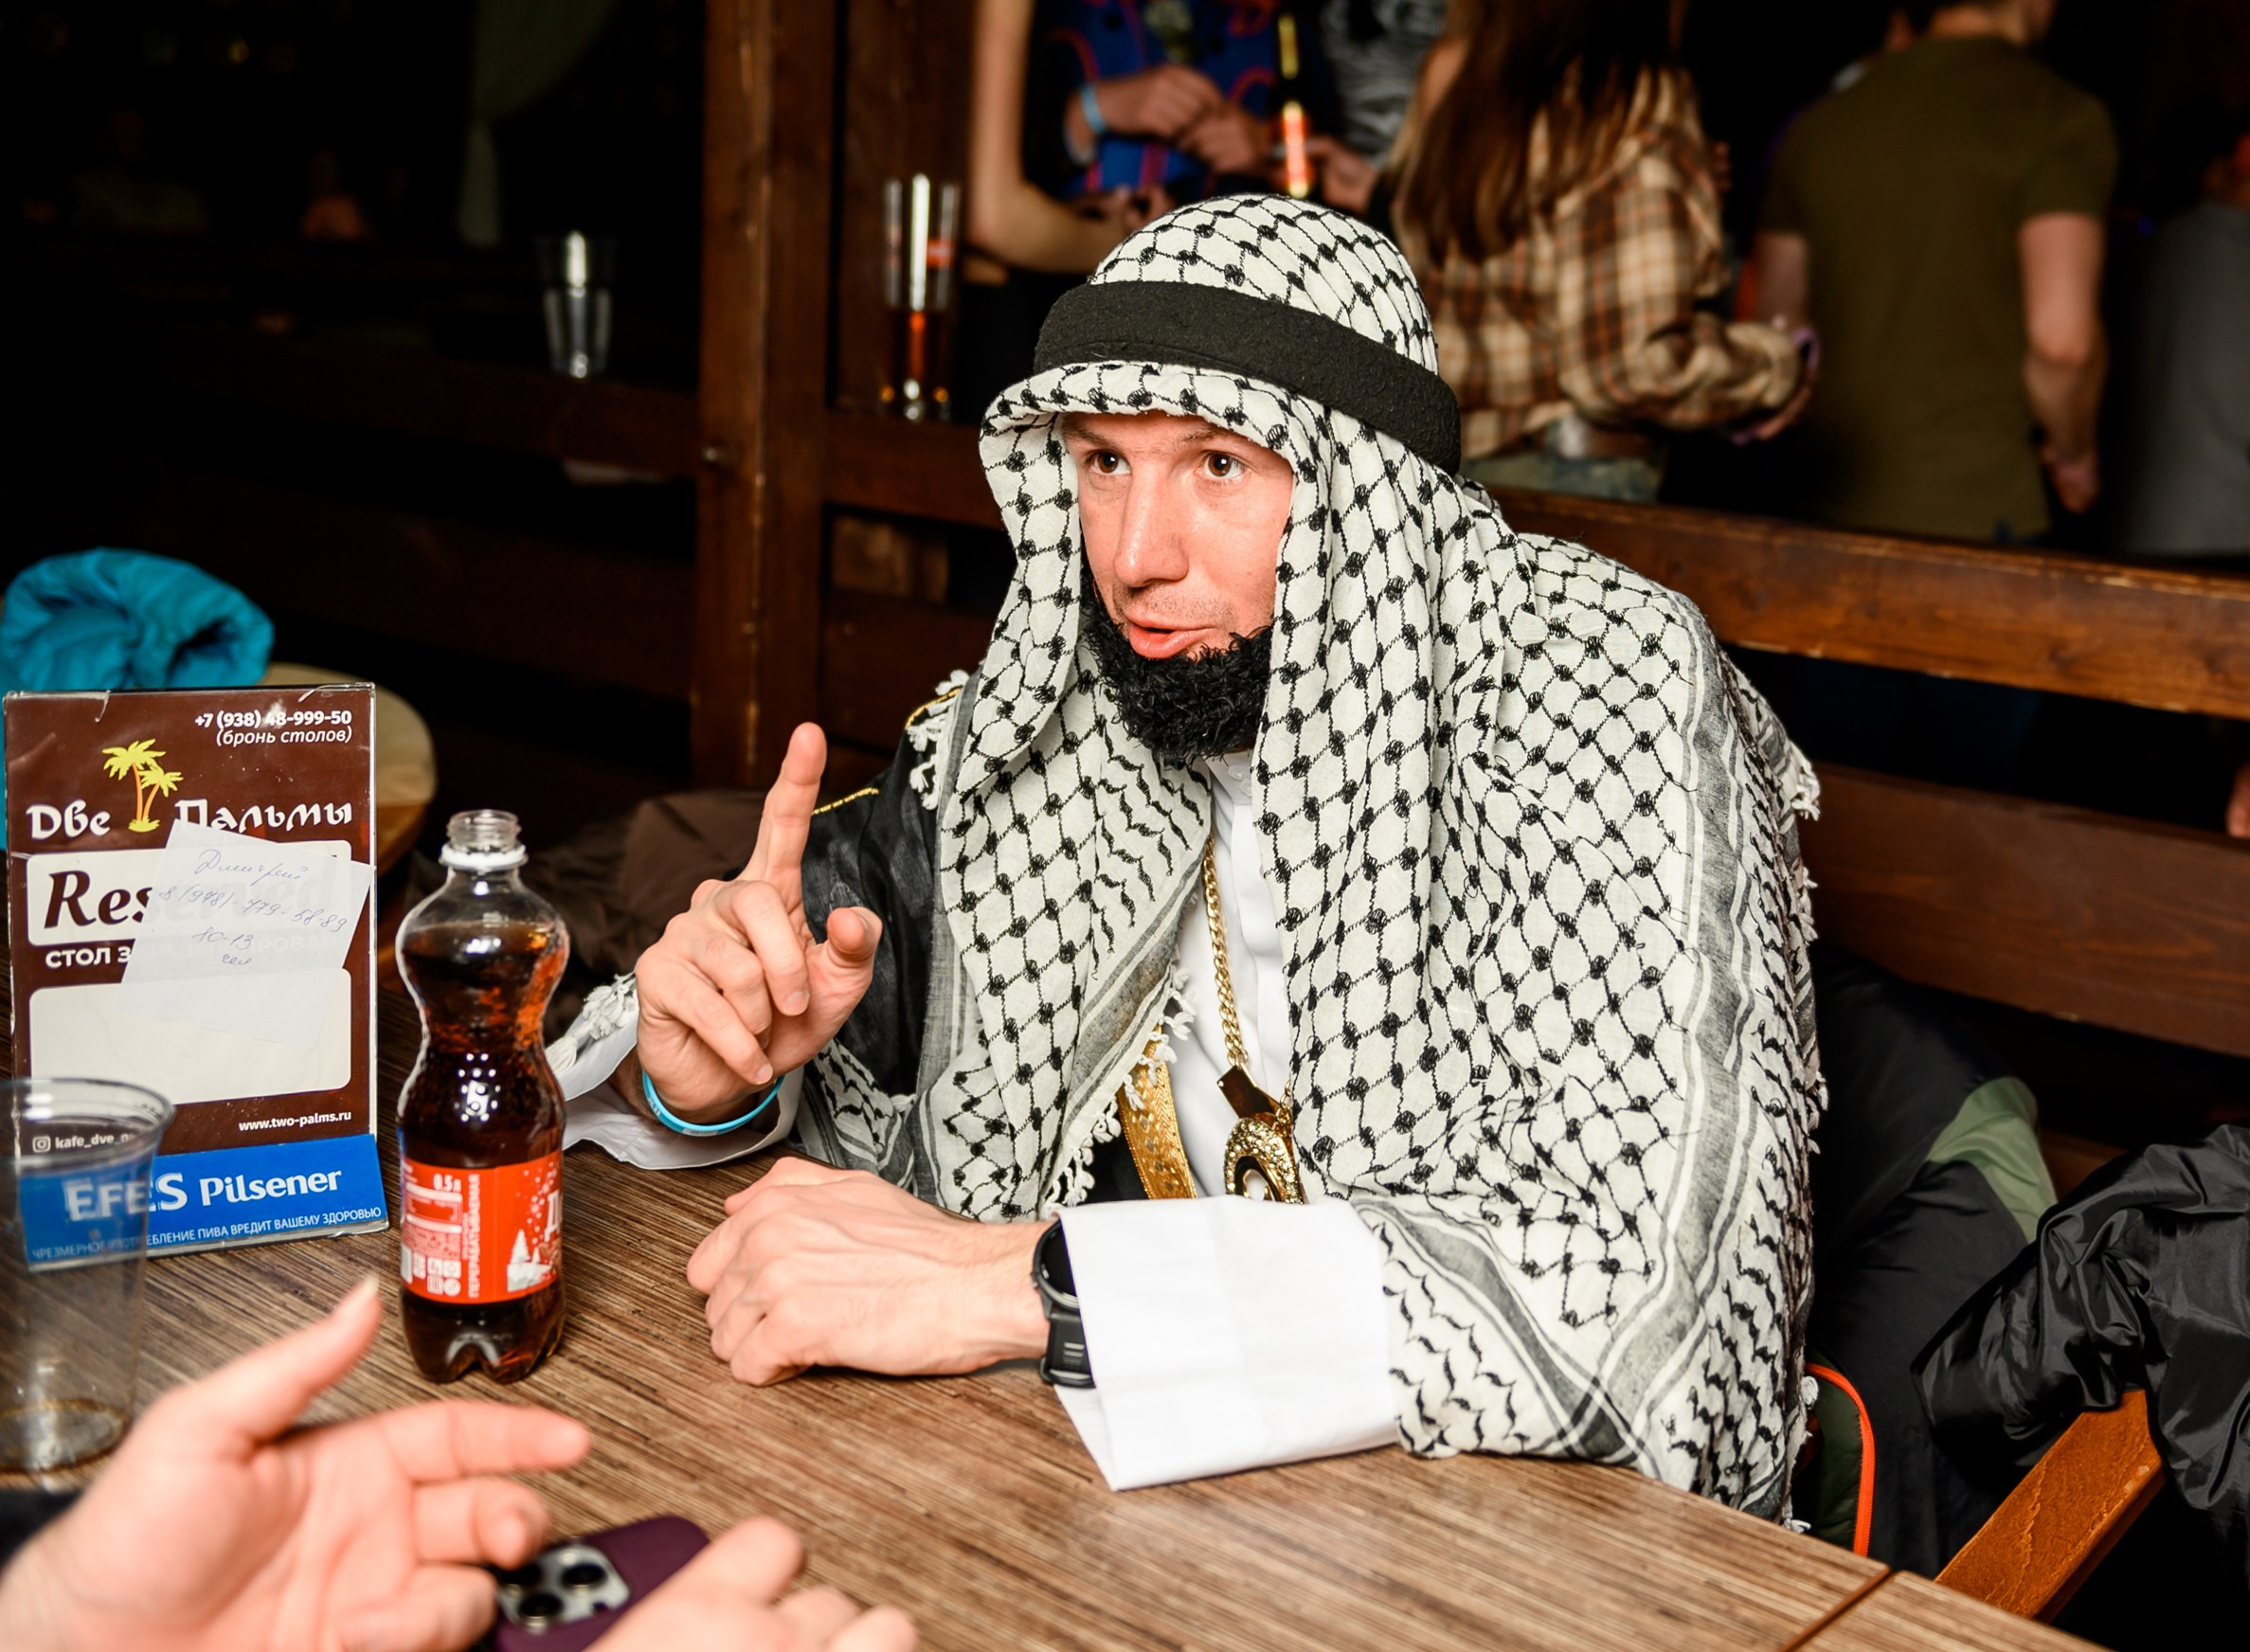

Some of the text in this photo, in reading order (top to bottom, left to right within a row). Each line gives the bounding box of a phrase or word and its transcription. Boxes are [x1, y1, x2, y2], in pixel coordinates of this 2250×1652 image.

[195, 709, 352, 730] +7 (938) 48-999-50
[216, 726, 352, 746] (бронь столов)
[26, 799, 352, 840] Две Пальмы
[45, 947, 111, 969] СТОЛ
[239, 1111, 351, 1131] www.two-palms.ru
[63, 1170, 342, 1222] EFES Pilsener
[197, 1225, 228, 1238] ПИВА
[230, 1219, 273, 1236] ВРЕДИТ
[274, 1213, 320, 1230] ВАШЕМУ
[323, 1207, 382, 1226] ЗДОРОВЬЮ
